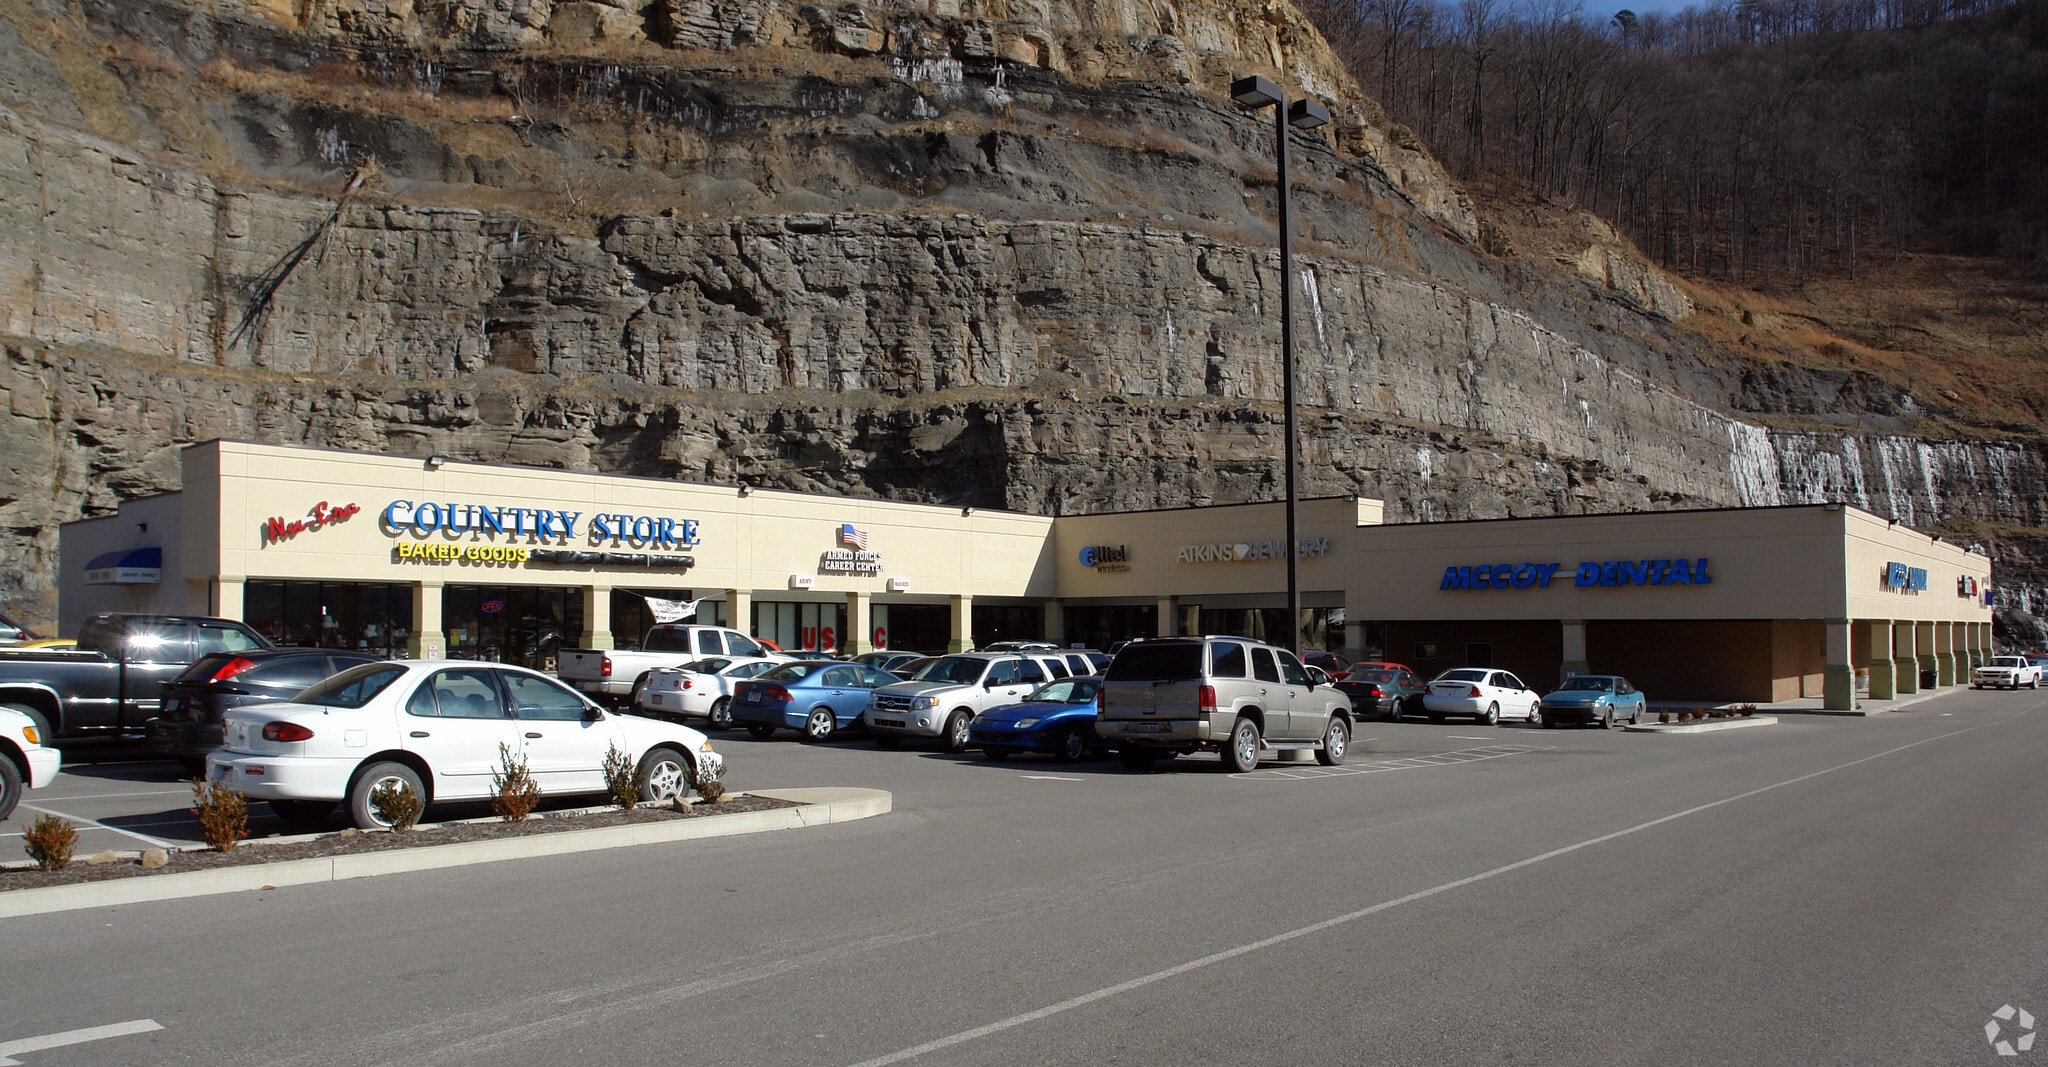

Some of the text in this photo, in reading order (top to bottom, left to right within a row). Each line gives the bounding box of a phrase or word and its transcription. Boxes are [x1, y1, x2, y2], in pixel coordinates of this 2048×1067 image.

[268, 501, 361, 541] Nu-Era
[386, 500, 701, 545] COUNTRY STORE
[399, 542, 528, 562] BAKED GOODS
[827, 551, 882, 561] ARMED FORCES
[1086, 544, 1127, 564] alltel
[1176, 543, 1234, 563] ATKINS
[825, 561, 884, 572] CAREER CENTER
[1440, 558, 1713, 591] MCCOY DENTAL
